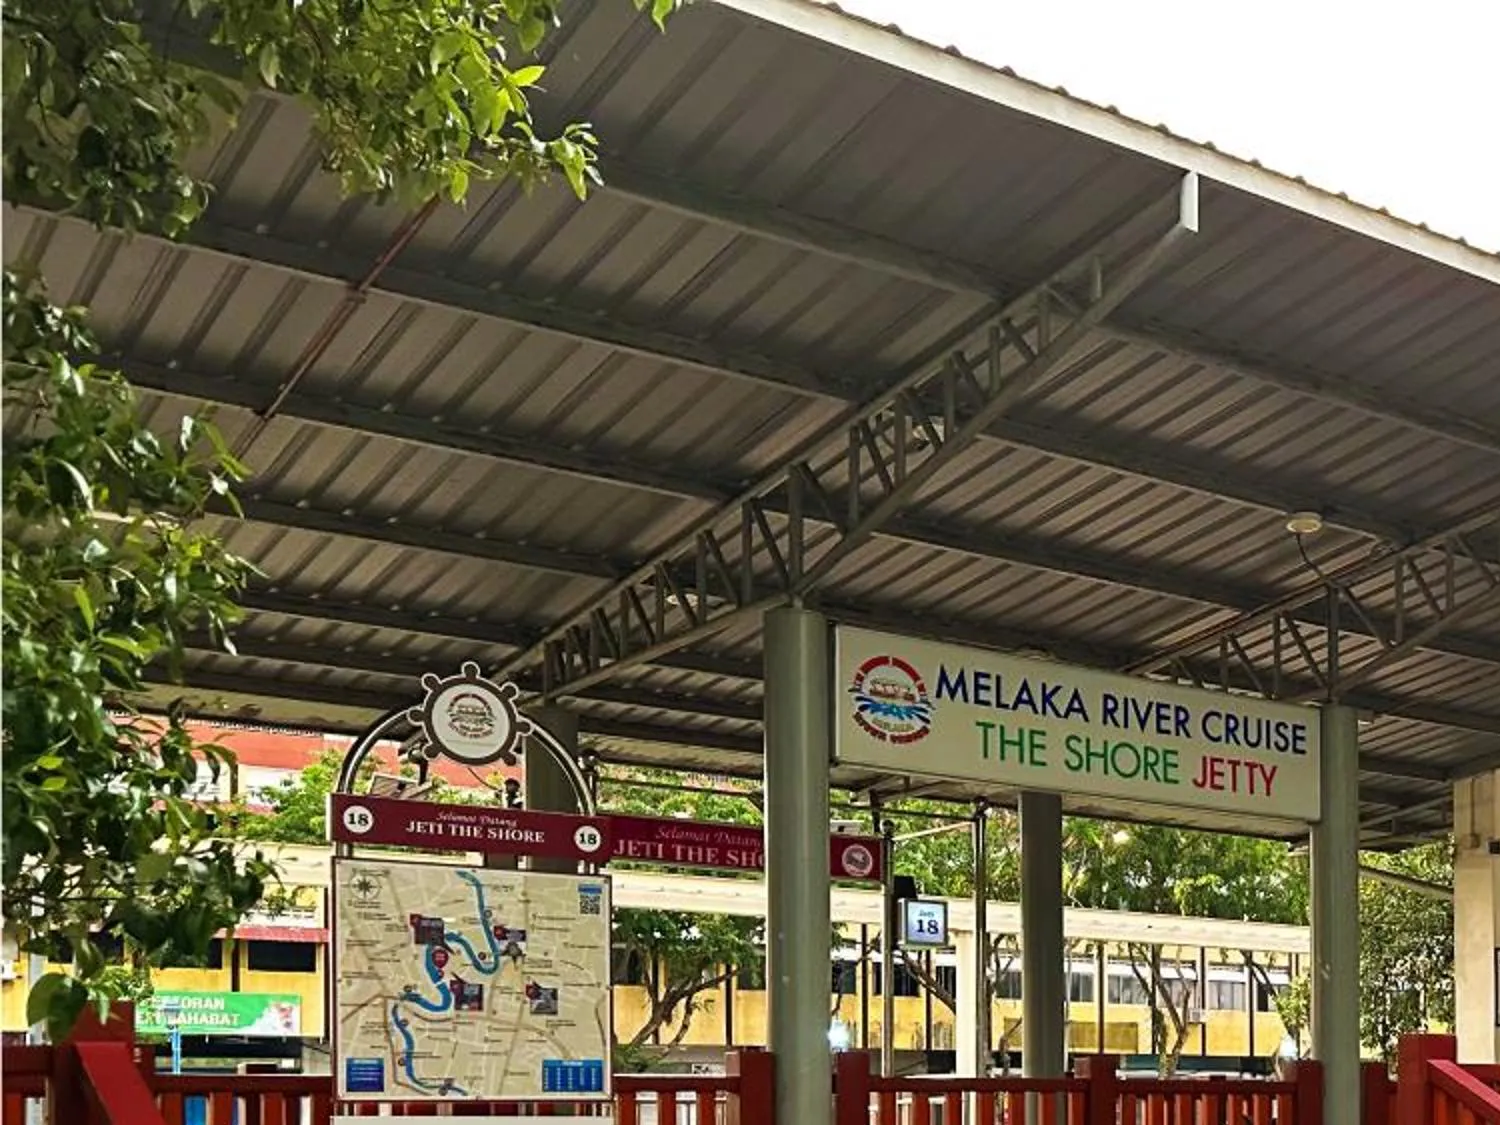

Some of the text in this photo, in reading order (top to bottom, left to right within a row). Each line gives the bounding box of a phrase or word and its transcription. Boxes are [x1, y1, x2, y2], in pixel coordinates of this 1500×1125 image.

[935, 664, 1308, 755] MELAKA RIVER CRUISE
[975, 720, 1048, 767] THE
[1063, 733, 1181, 785] SHORE
[1192, 754, 1279, 798] JETTY
[348, 812, 369, 826] 18
[405, 820, 545, 843] JETI THE SHORE
[579, 832, 597, 846] 18
[613, 839, 664, 859] JETI
[672, 843, 719, 865] THE
[916, 919, 939, 935] 18
